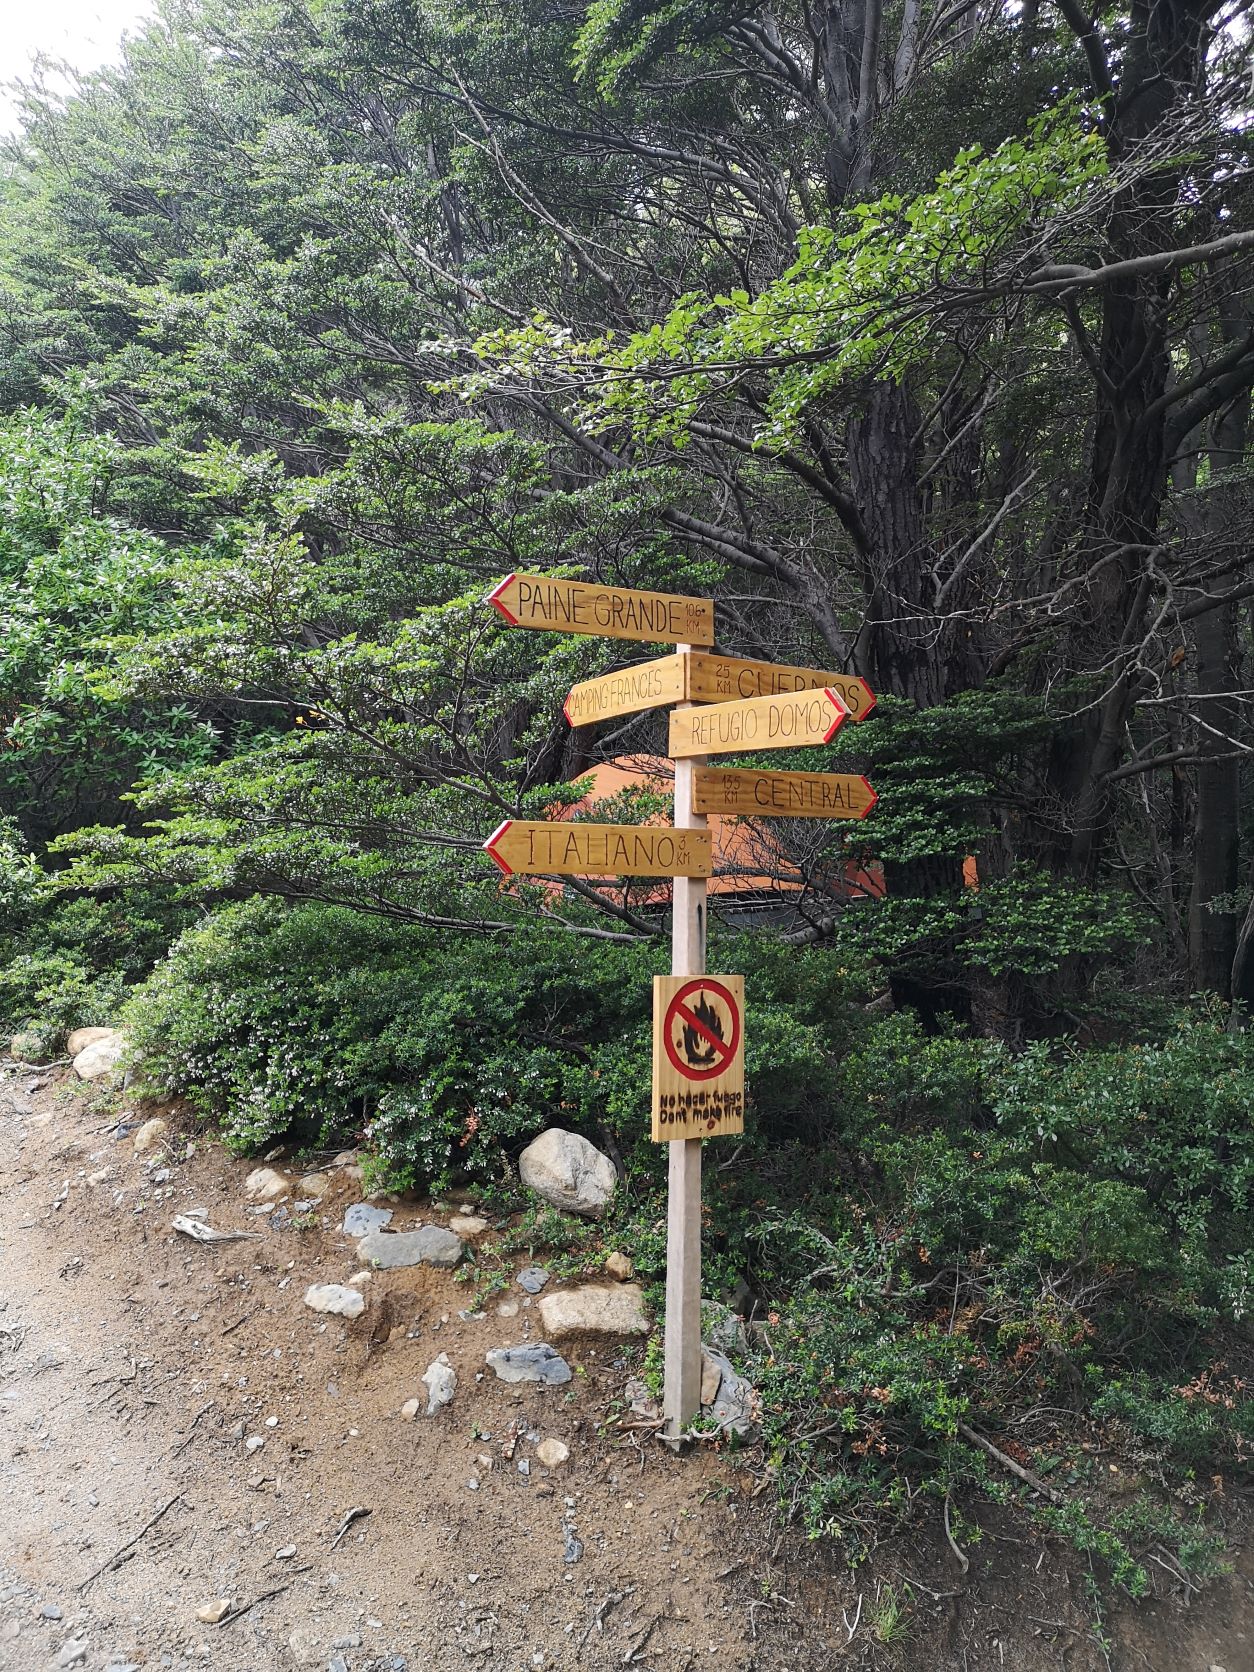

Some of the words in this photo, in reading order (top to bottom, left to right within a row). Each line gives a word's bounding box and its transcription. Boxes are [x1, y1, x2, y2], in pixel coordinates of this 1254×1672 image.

[519, 582, 589, 625] PAINE
[594, 593, 684, 635] GRANDE
[568, 683, 610, 717] CAMPING
[610, 669, 662, 707] FRANCES
[716, 680, 731, 695] KM
[691, 708, 758, 745] REFUGIO
[769, 700, 832, 737] DOMOS
[724, 790, 738, 804] KM
[754, 778, 859, 809] CENTRAL
[527, 829, 675, 867] ITALIANO
[678, 836, 686, 850] 3
[676, 851, 690, 867] KM
[660, 1094, 676, 1108] No
[712, 1090, 742, 1105] fuego
